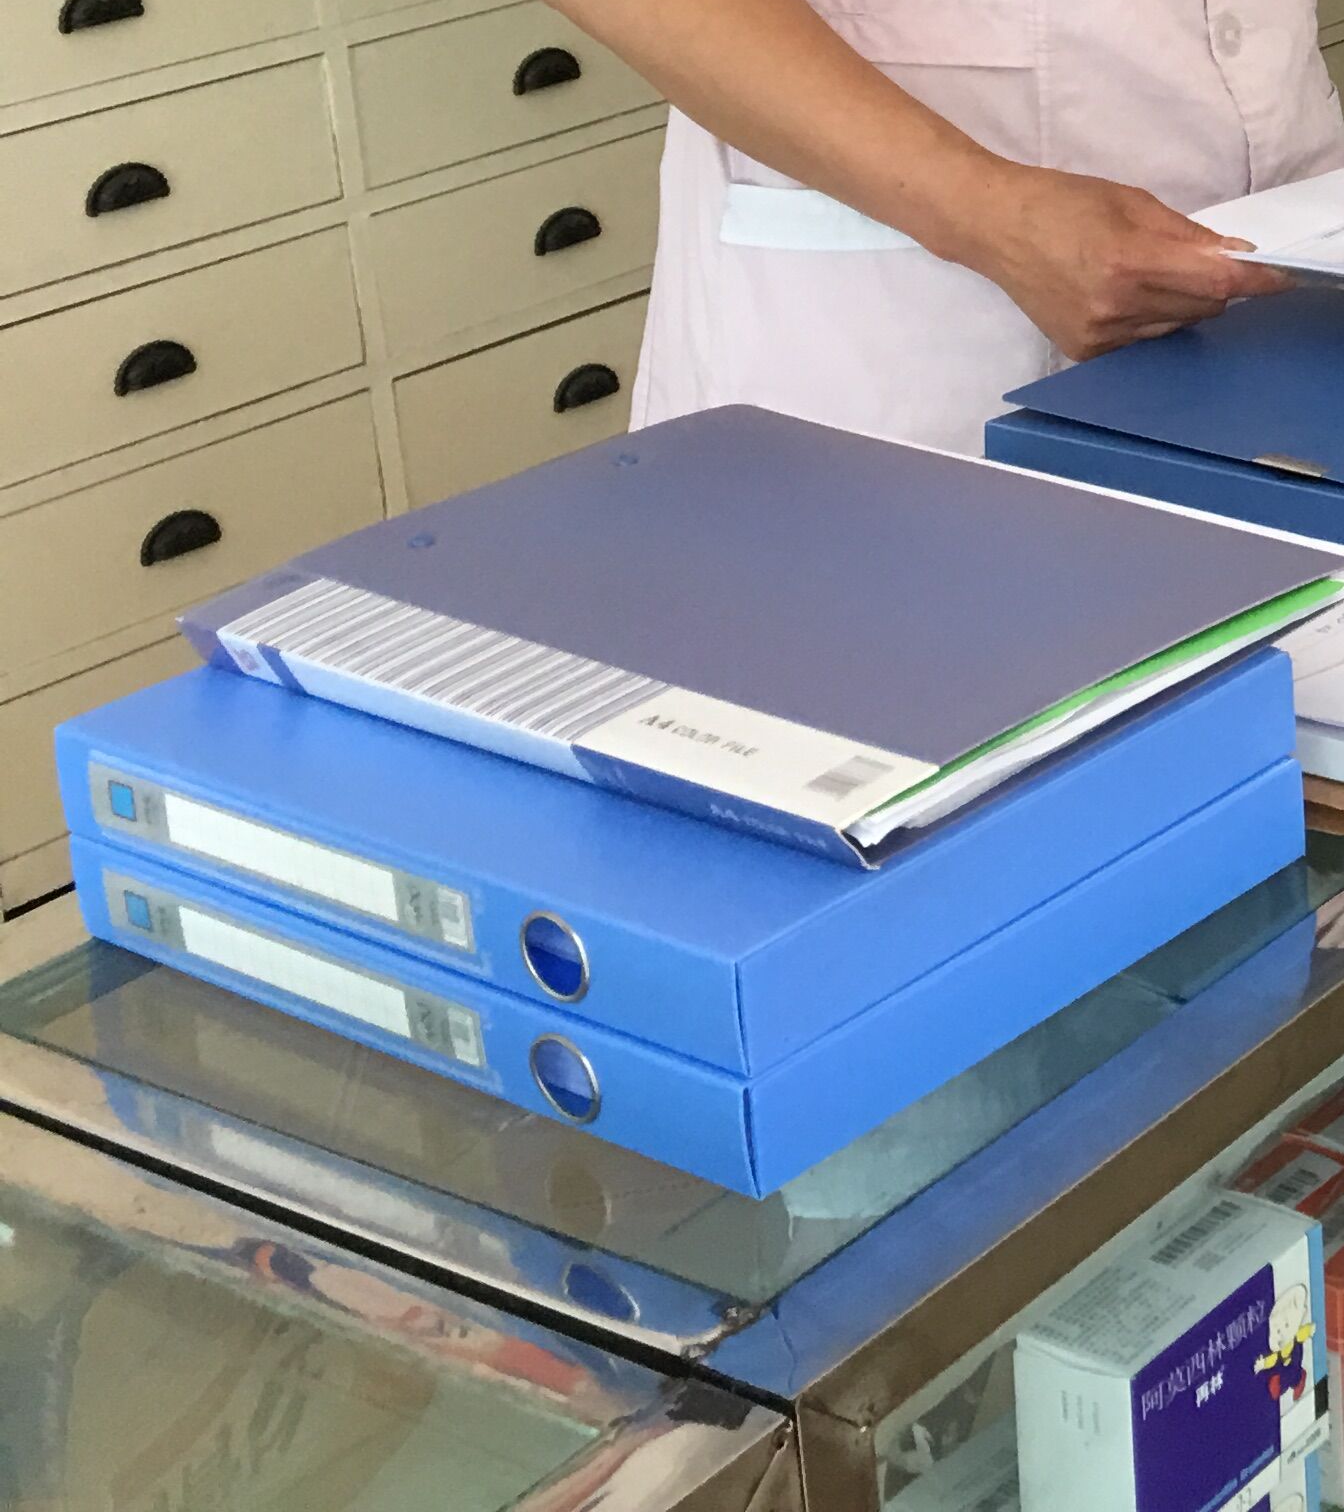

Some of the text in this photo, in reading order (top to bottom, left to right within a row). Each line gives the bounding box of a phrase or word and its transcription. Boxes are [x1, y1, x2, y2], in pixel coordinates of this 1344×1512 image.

[640, 714, 675, 730] A4
[1140, 1299, 1267, 1422] 阿莫西林颗粒
